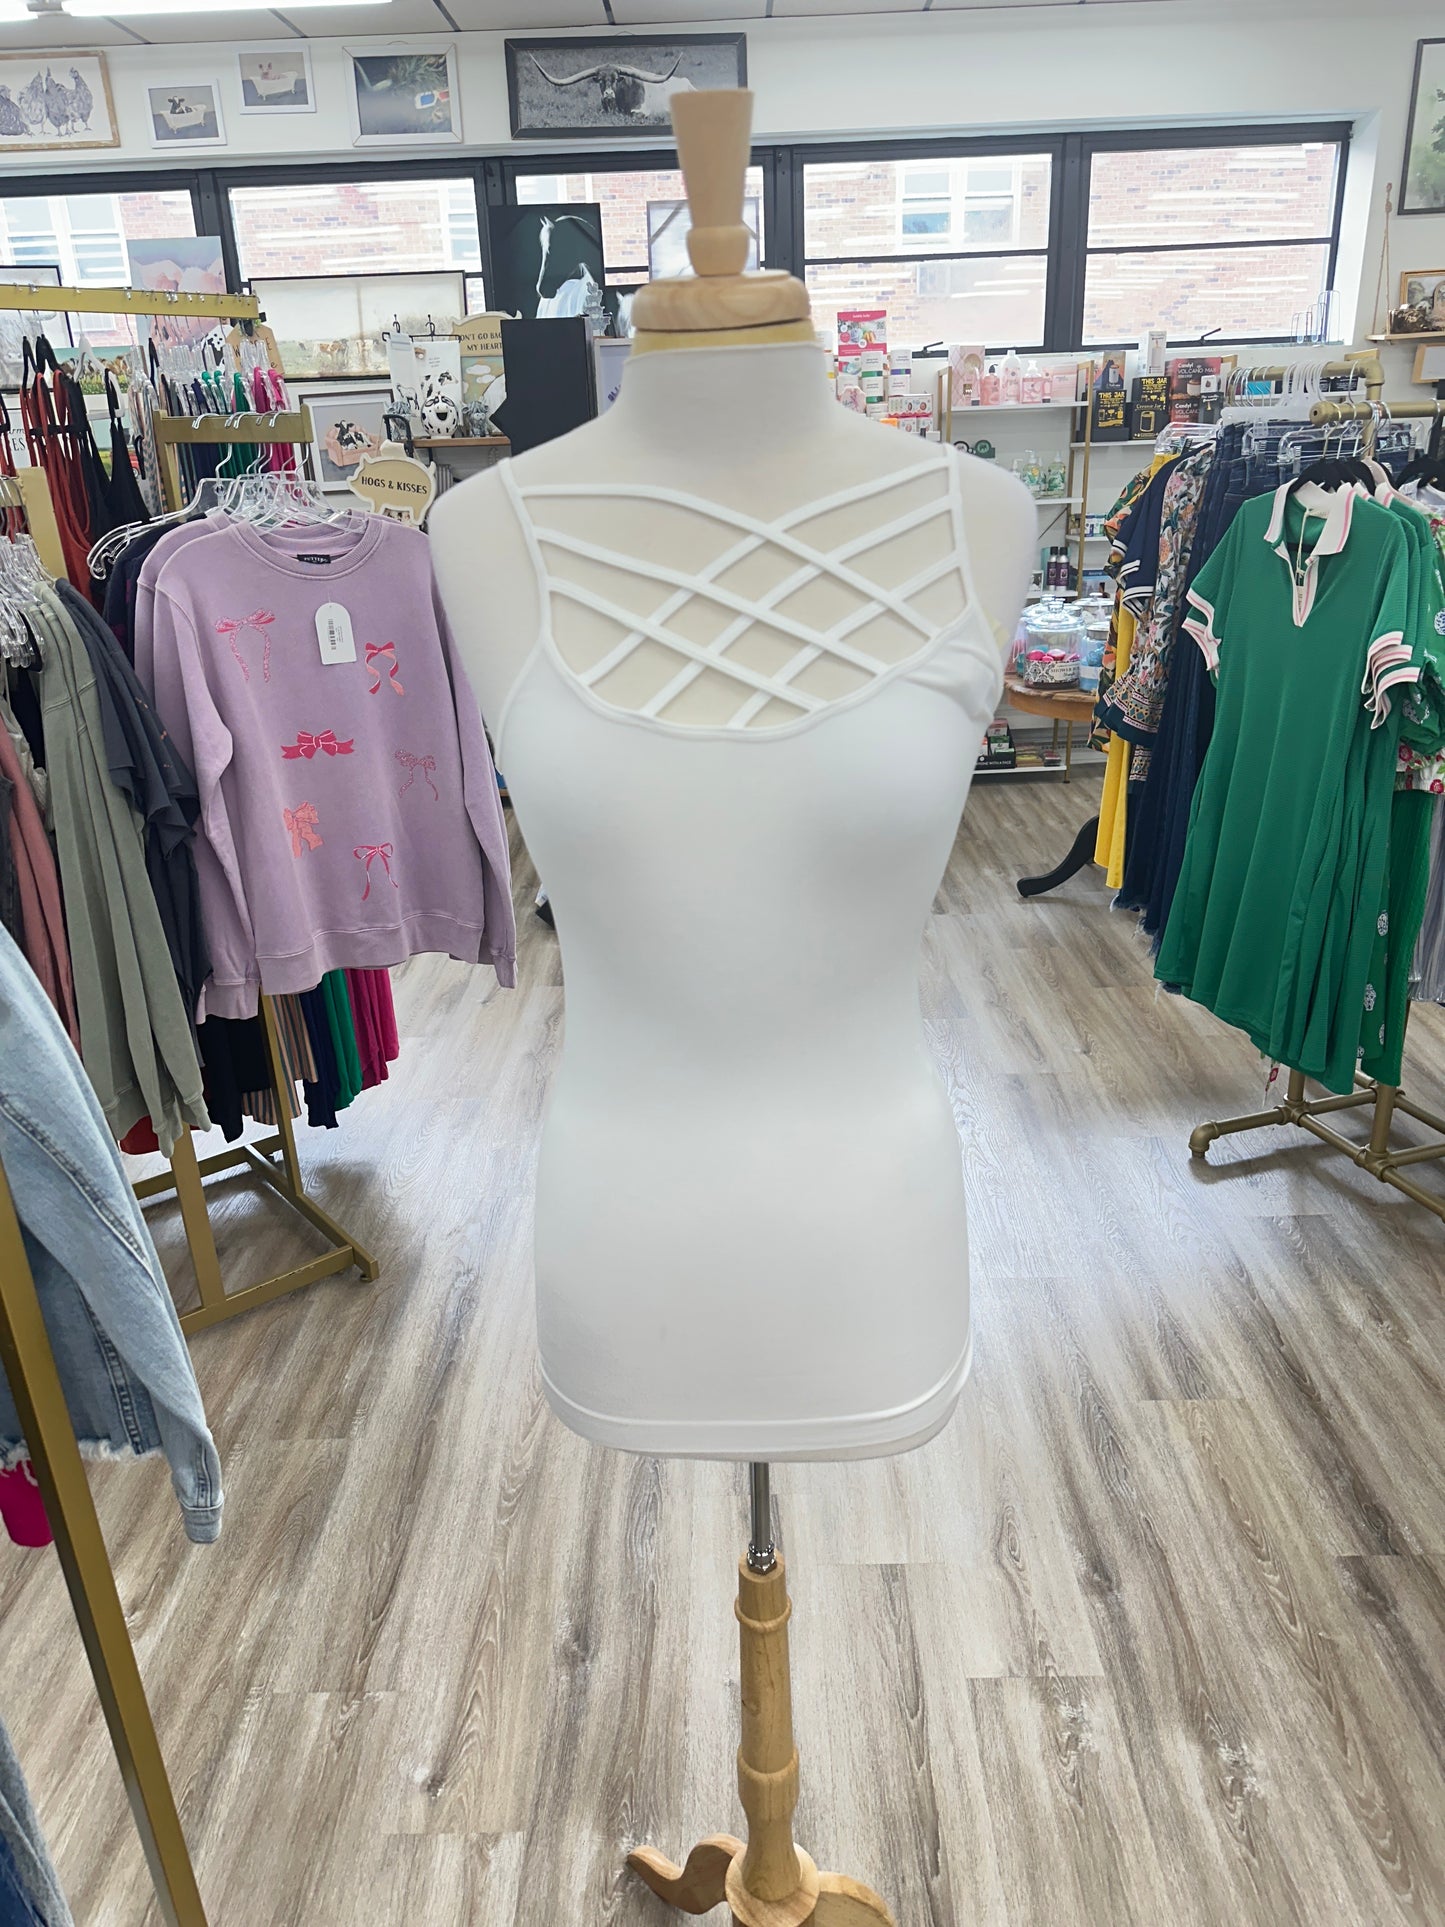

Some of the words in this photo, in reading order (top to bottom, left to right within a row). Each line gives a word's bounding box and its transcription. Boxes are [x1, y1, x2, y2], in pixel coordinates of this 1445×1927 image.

[477, 332, 488, 340] GO
[467, 343, 478, 351] MY
[480, 342, 502, 351] HEART
[1141, 378, 1155, 386] THIS
[361, 476, 386, 488] HOGS
[388, 480, 394, 489] &
[396, 481, 428, 494] KISSES
